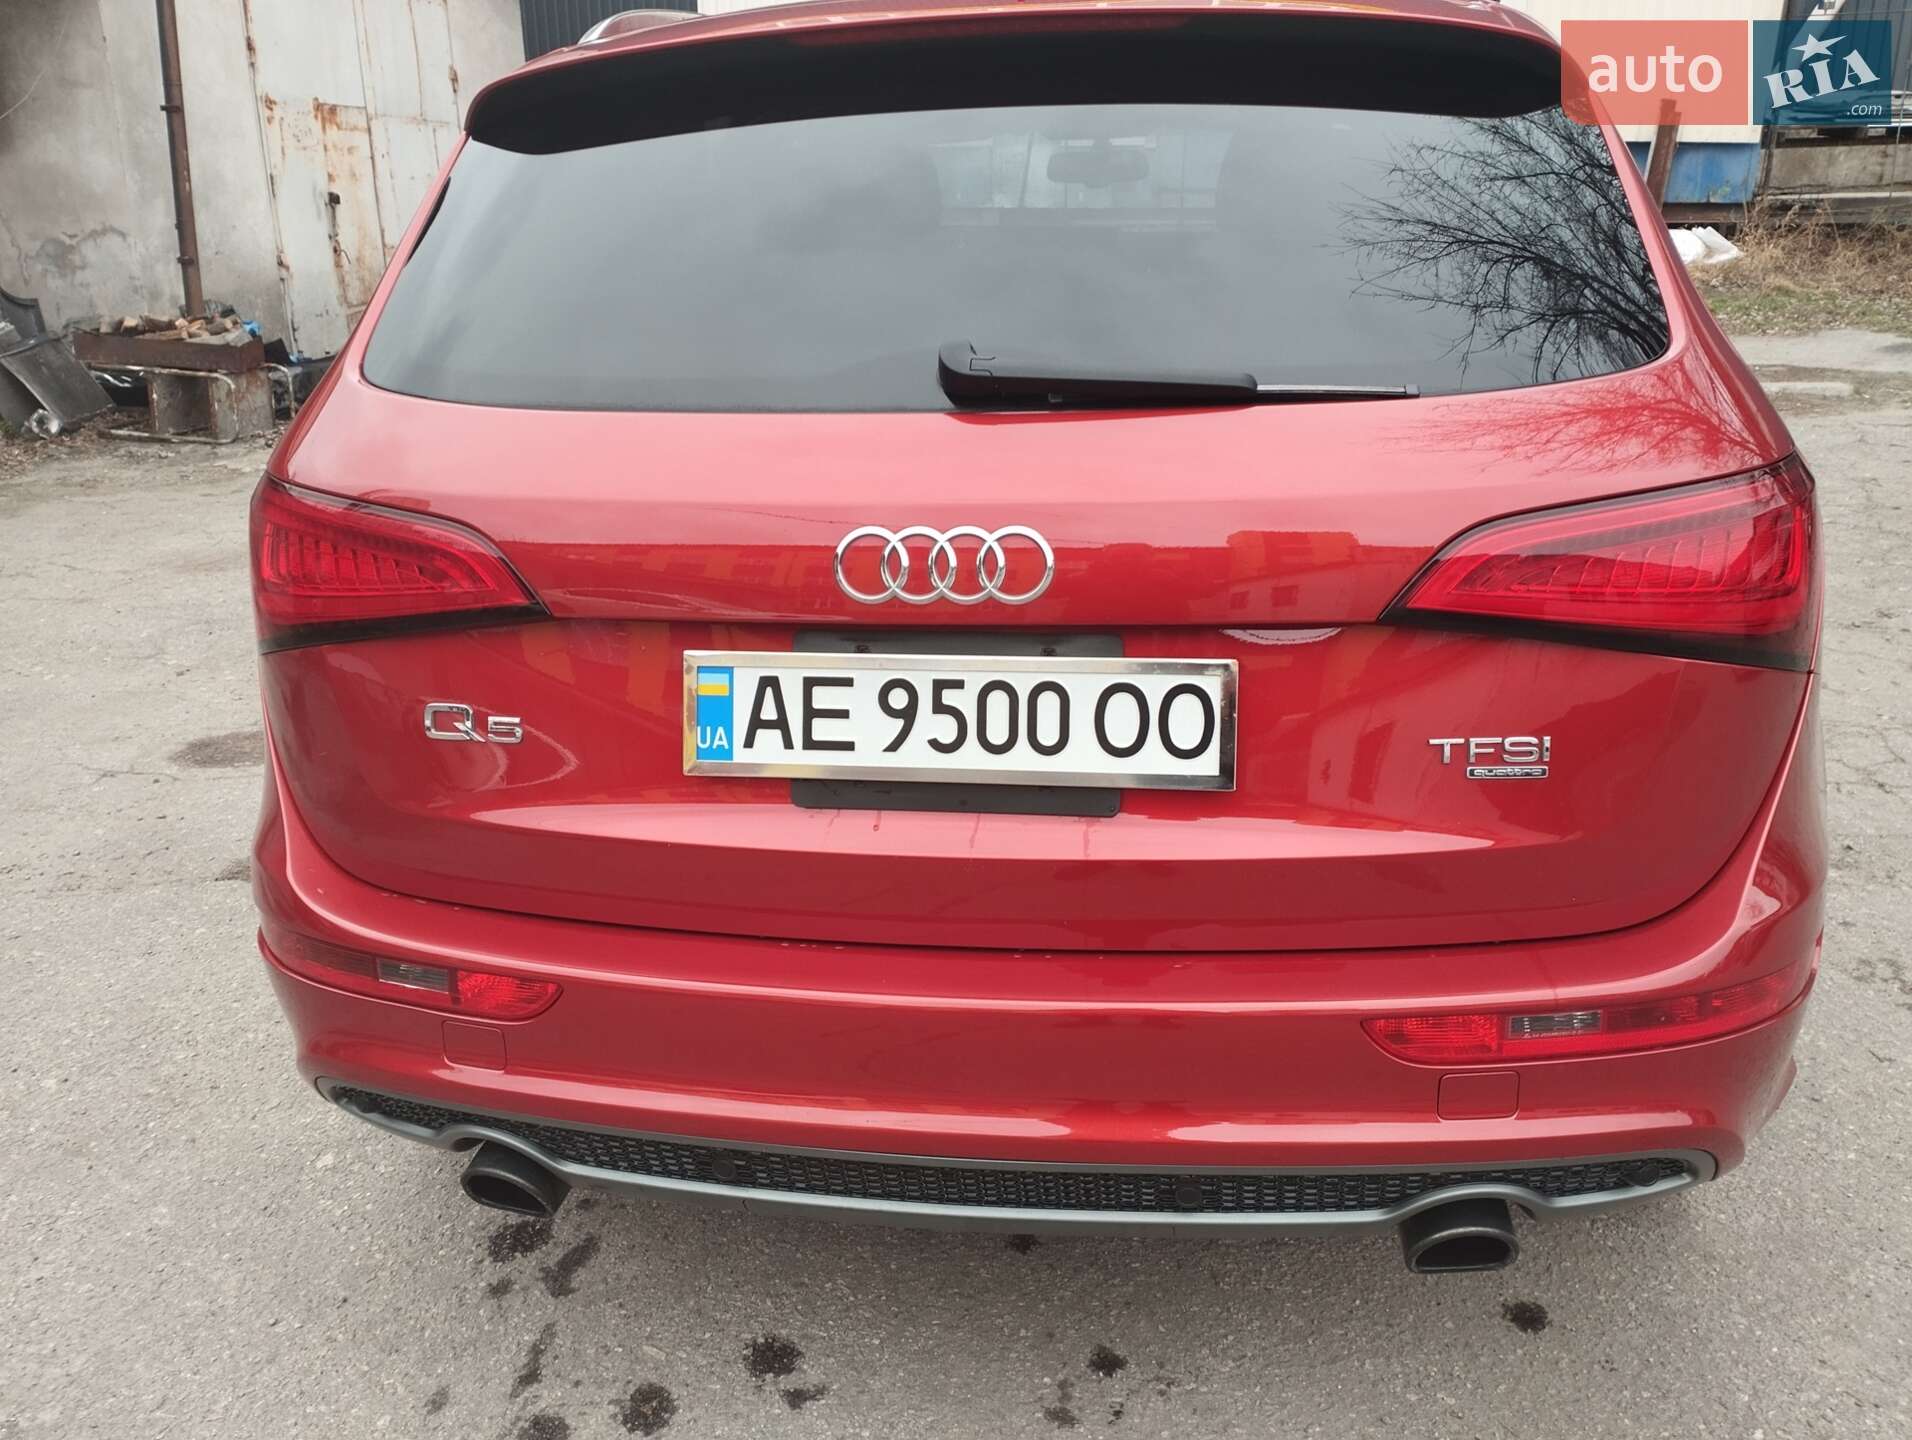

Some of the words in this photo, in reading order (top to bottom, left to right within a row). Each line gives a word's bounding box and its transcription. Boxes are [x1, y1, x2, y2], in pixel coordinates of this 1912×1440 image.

[424, 703, 523, 744] Q5
[743, 675, 855, 751] AE
[877, 678, 1071, 757] 9500
[1094, 681, 1216, 760] OO
[697, 725, 730, 750] UA
[1428, 735, 1552, 764] TFSI
[1473, 767, 1543, 778] quattro
